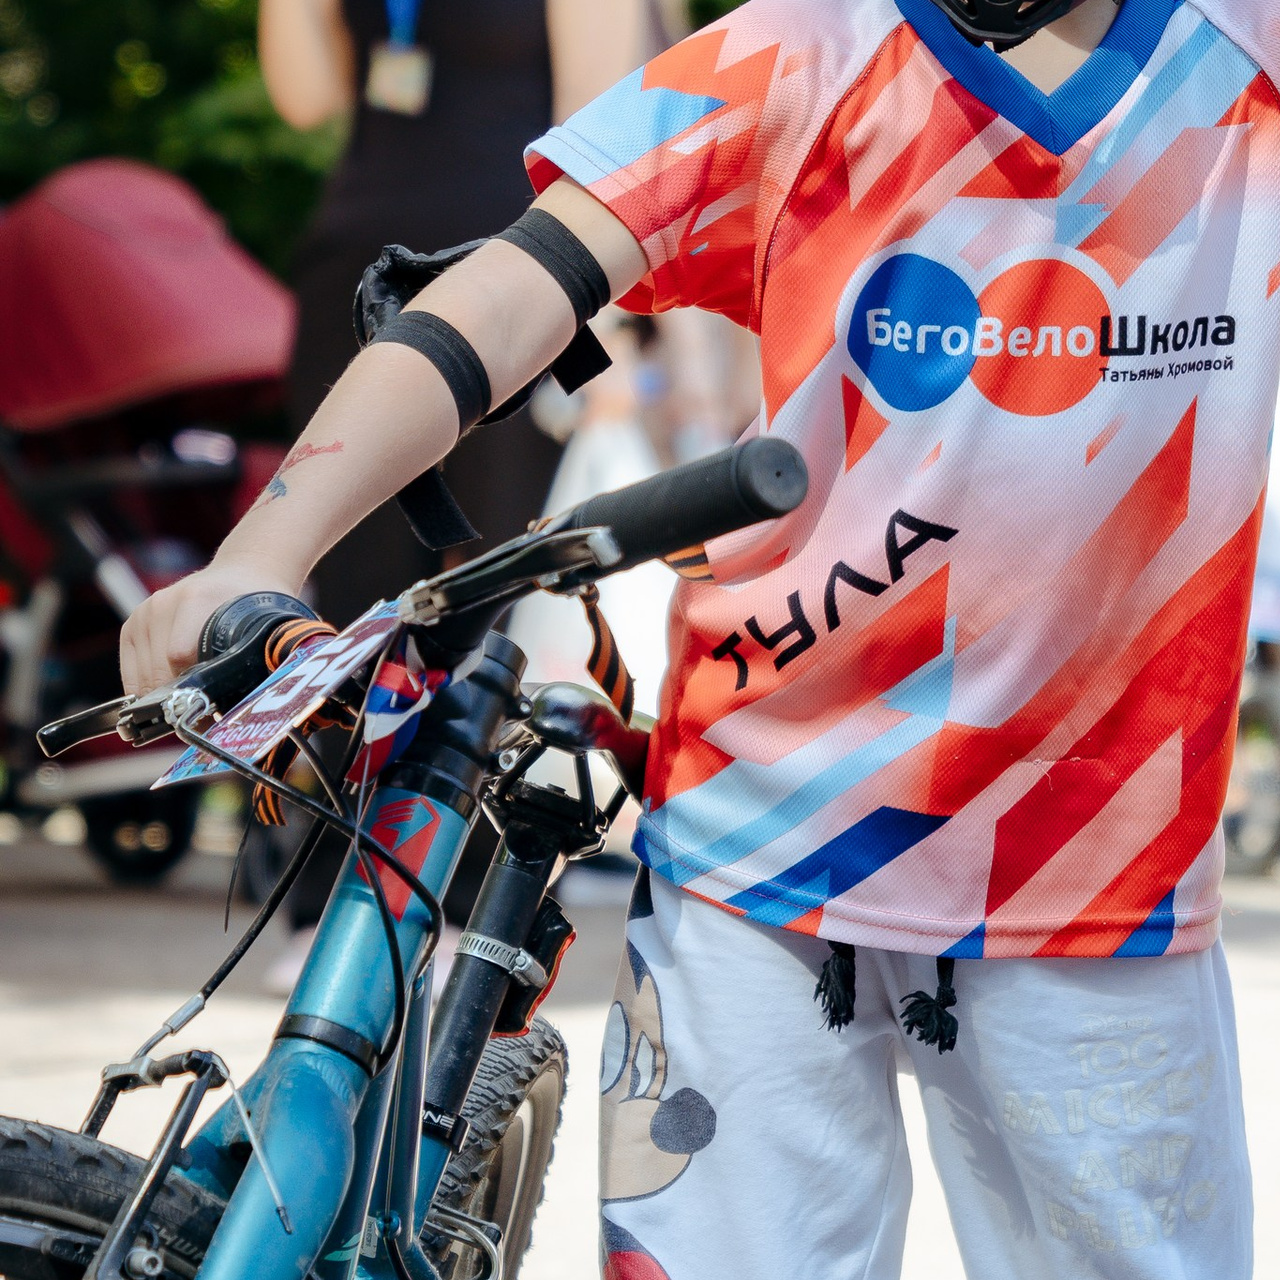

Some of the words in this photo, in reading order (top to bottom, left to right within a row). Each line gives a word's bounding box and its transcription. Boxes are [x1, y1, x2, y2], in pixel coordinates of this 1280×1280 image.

[1099, 366, 1164, 383] Татьяны
[1166, 356, 1235, 380] Хромовой
[711, 506, 959, 692] ТУЛА
[1068, 1033, 1169, 1079] 100
[1004, 1053, 1217, 1135] MICKEY
[1071, 1134, 1194, 1195] AND
[1047, 1180, 1218, 1252] PLUTO
